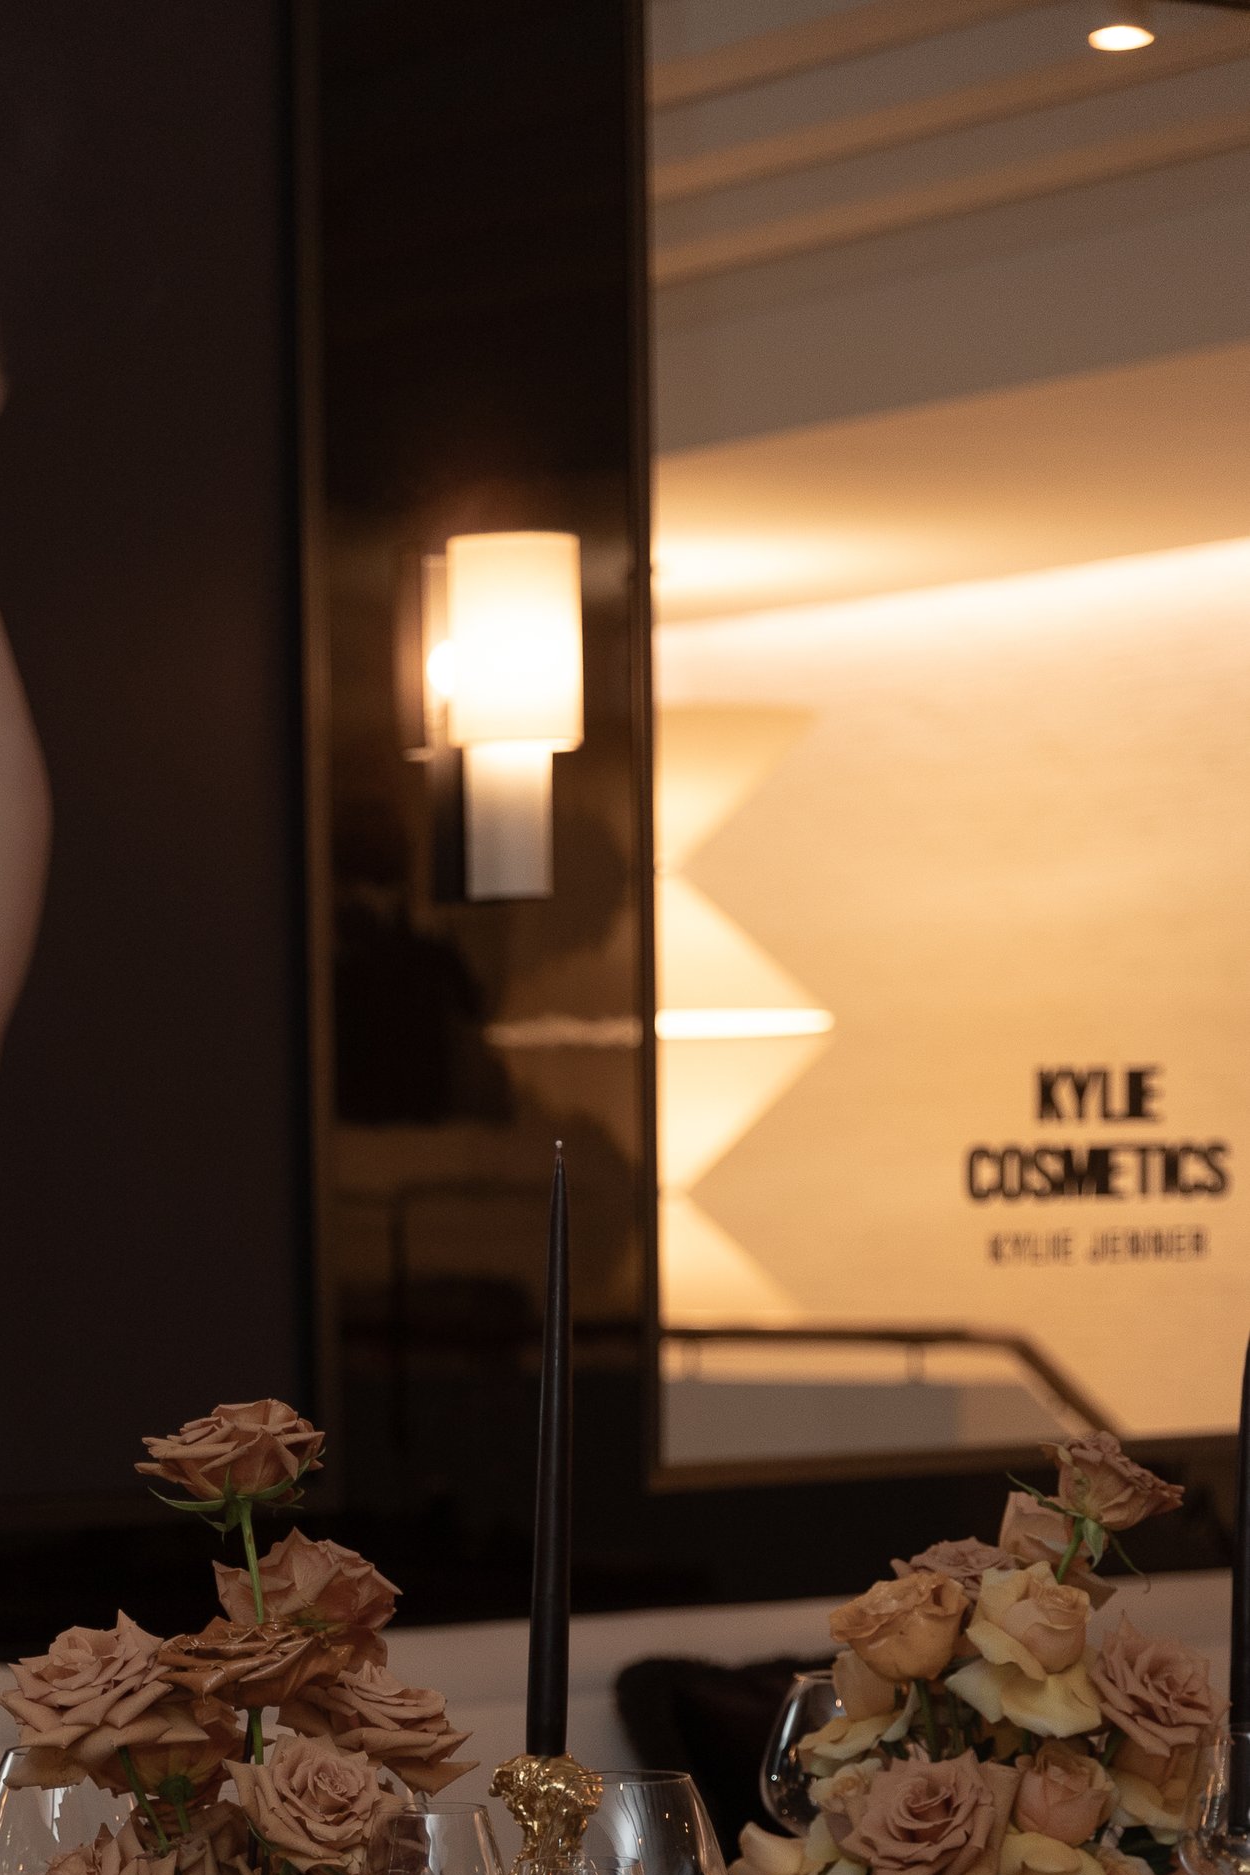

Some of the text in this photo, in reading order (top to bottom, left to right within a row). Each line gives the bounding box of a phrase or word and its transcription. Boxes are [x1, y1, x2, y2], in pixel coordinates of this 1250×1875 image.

[1036, 1066, 1161, 1122] KYLIE
[966, 1142, 1230, 1199] COSMETICS
[989, 1226, 1206, 1264] KYLIE JENNER
